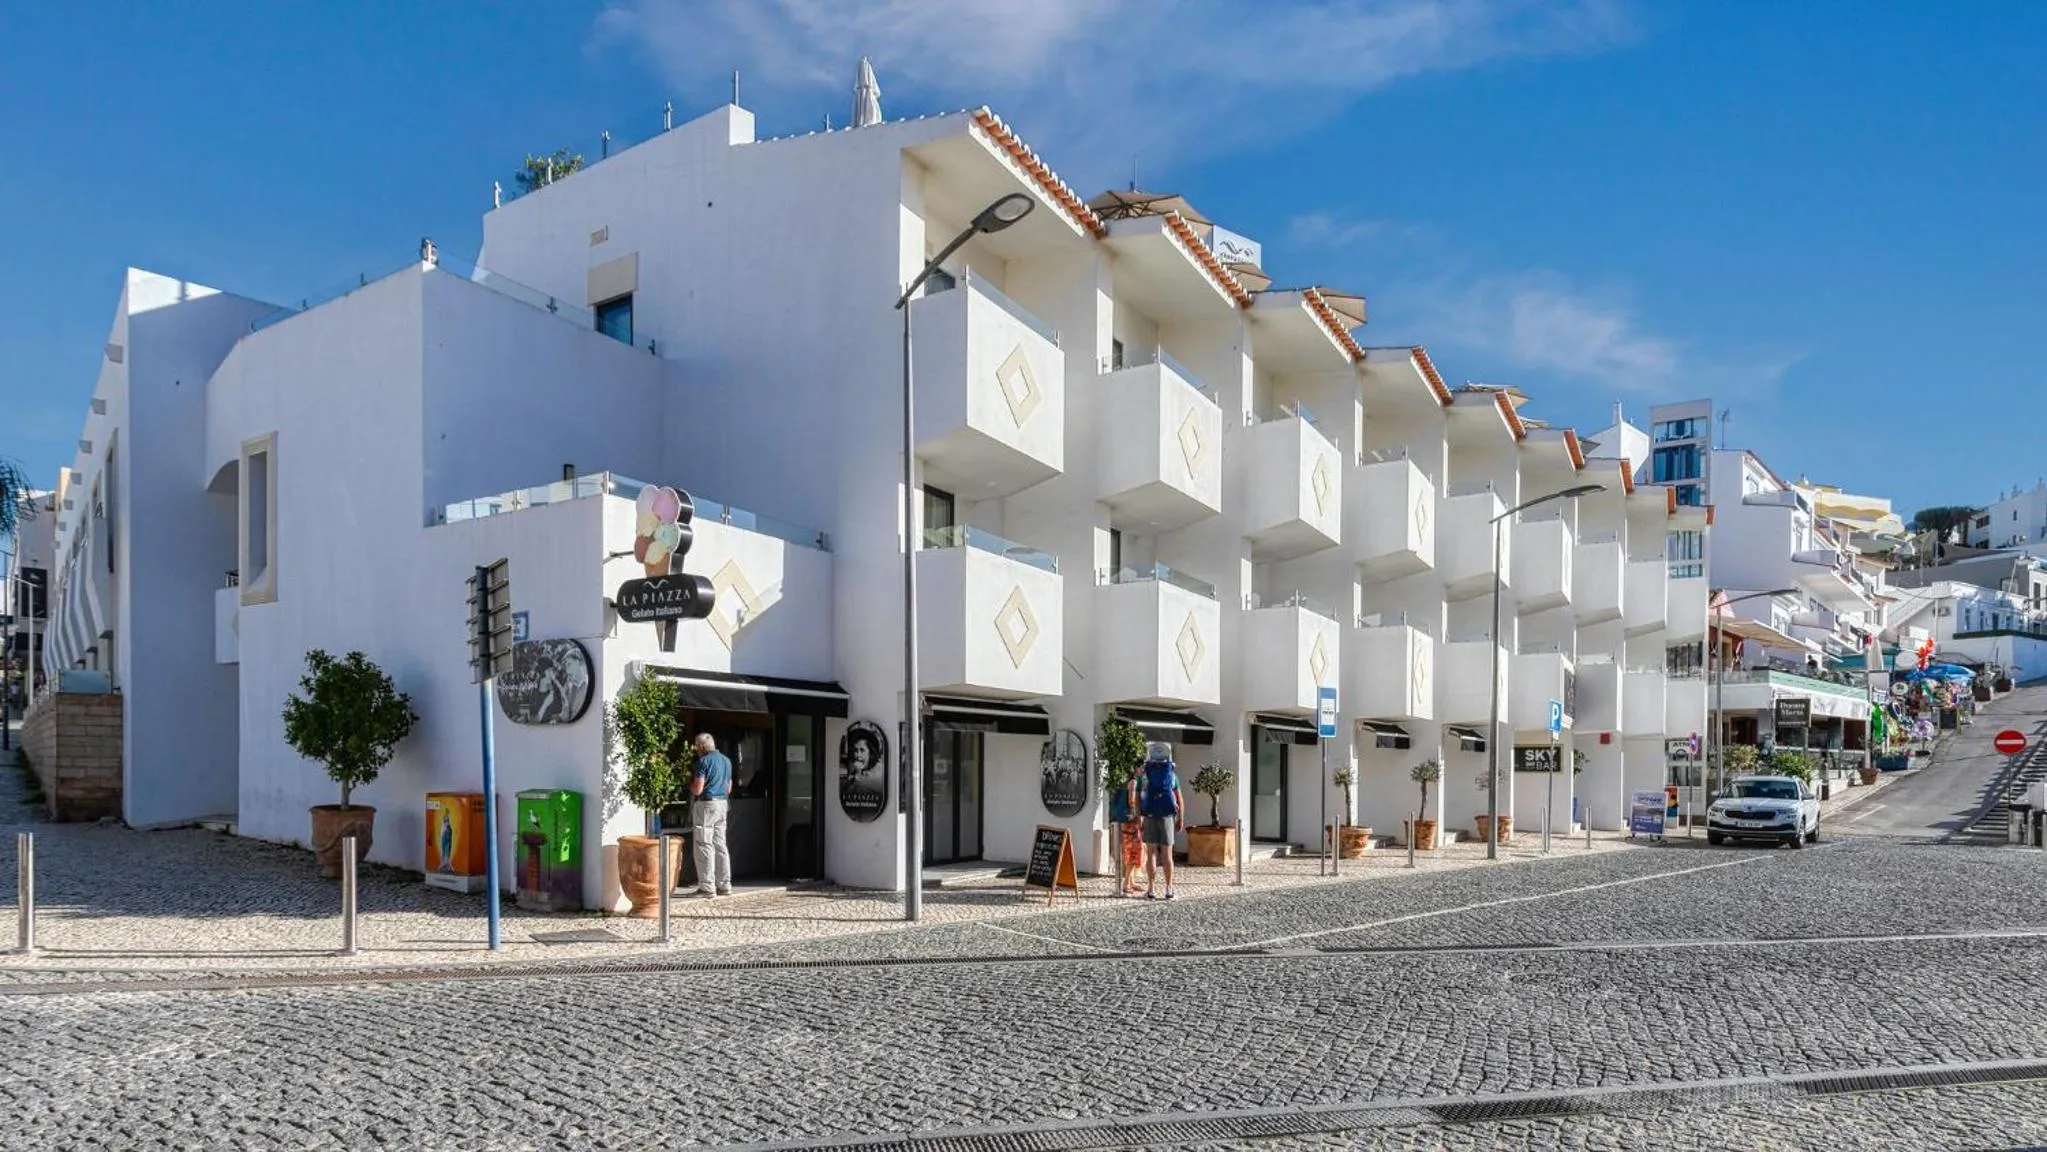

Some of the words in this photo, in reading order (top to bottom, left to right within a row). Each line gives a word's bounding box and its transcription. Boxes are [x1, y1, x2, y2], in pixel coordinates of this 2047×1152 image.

[622, 595, 637, 606] LA
[642, 589, 691, 604] PIAZZA
[631, 608, 655, 618] Gelato
[655, 605, 683, 616] Italiano
[1552, 703, 1560, 729] P
[1524, 749, 1557, 761] SKY
[1536, 761, 1557, 771] BAR
